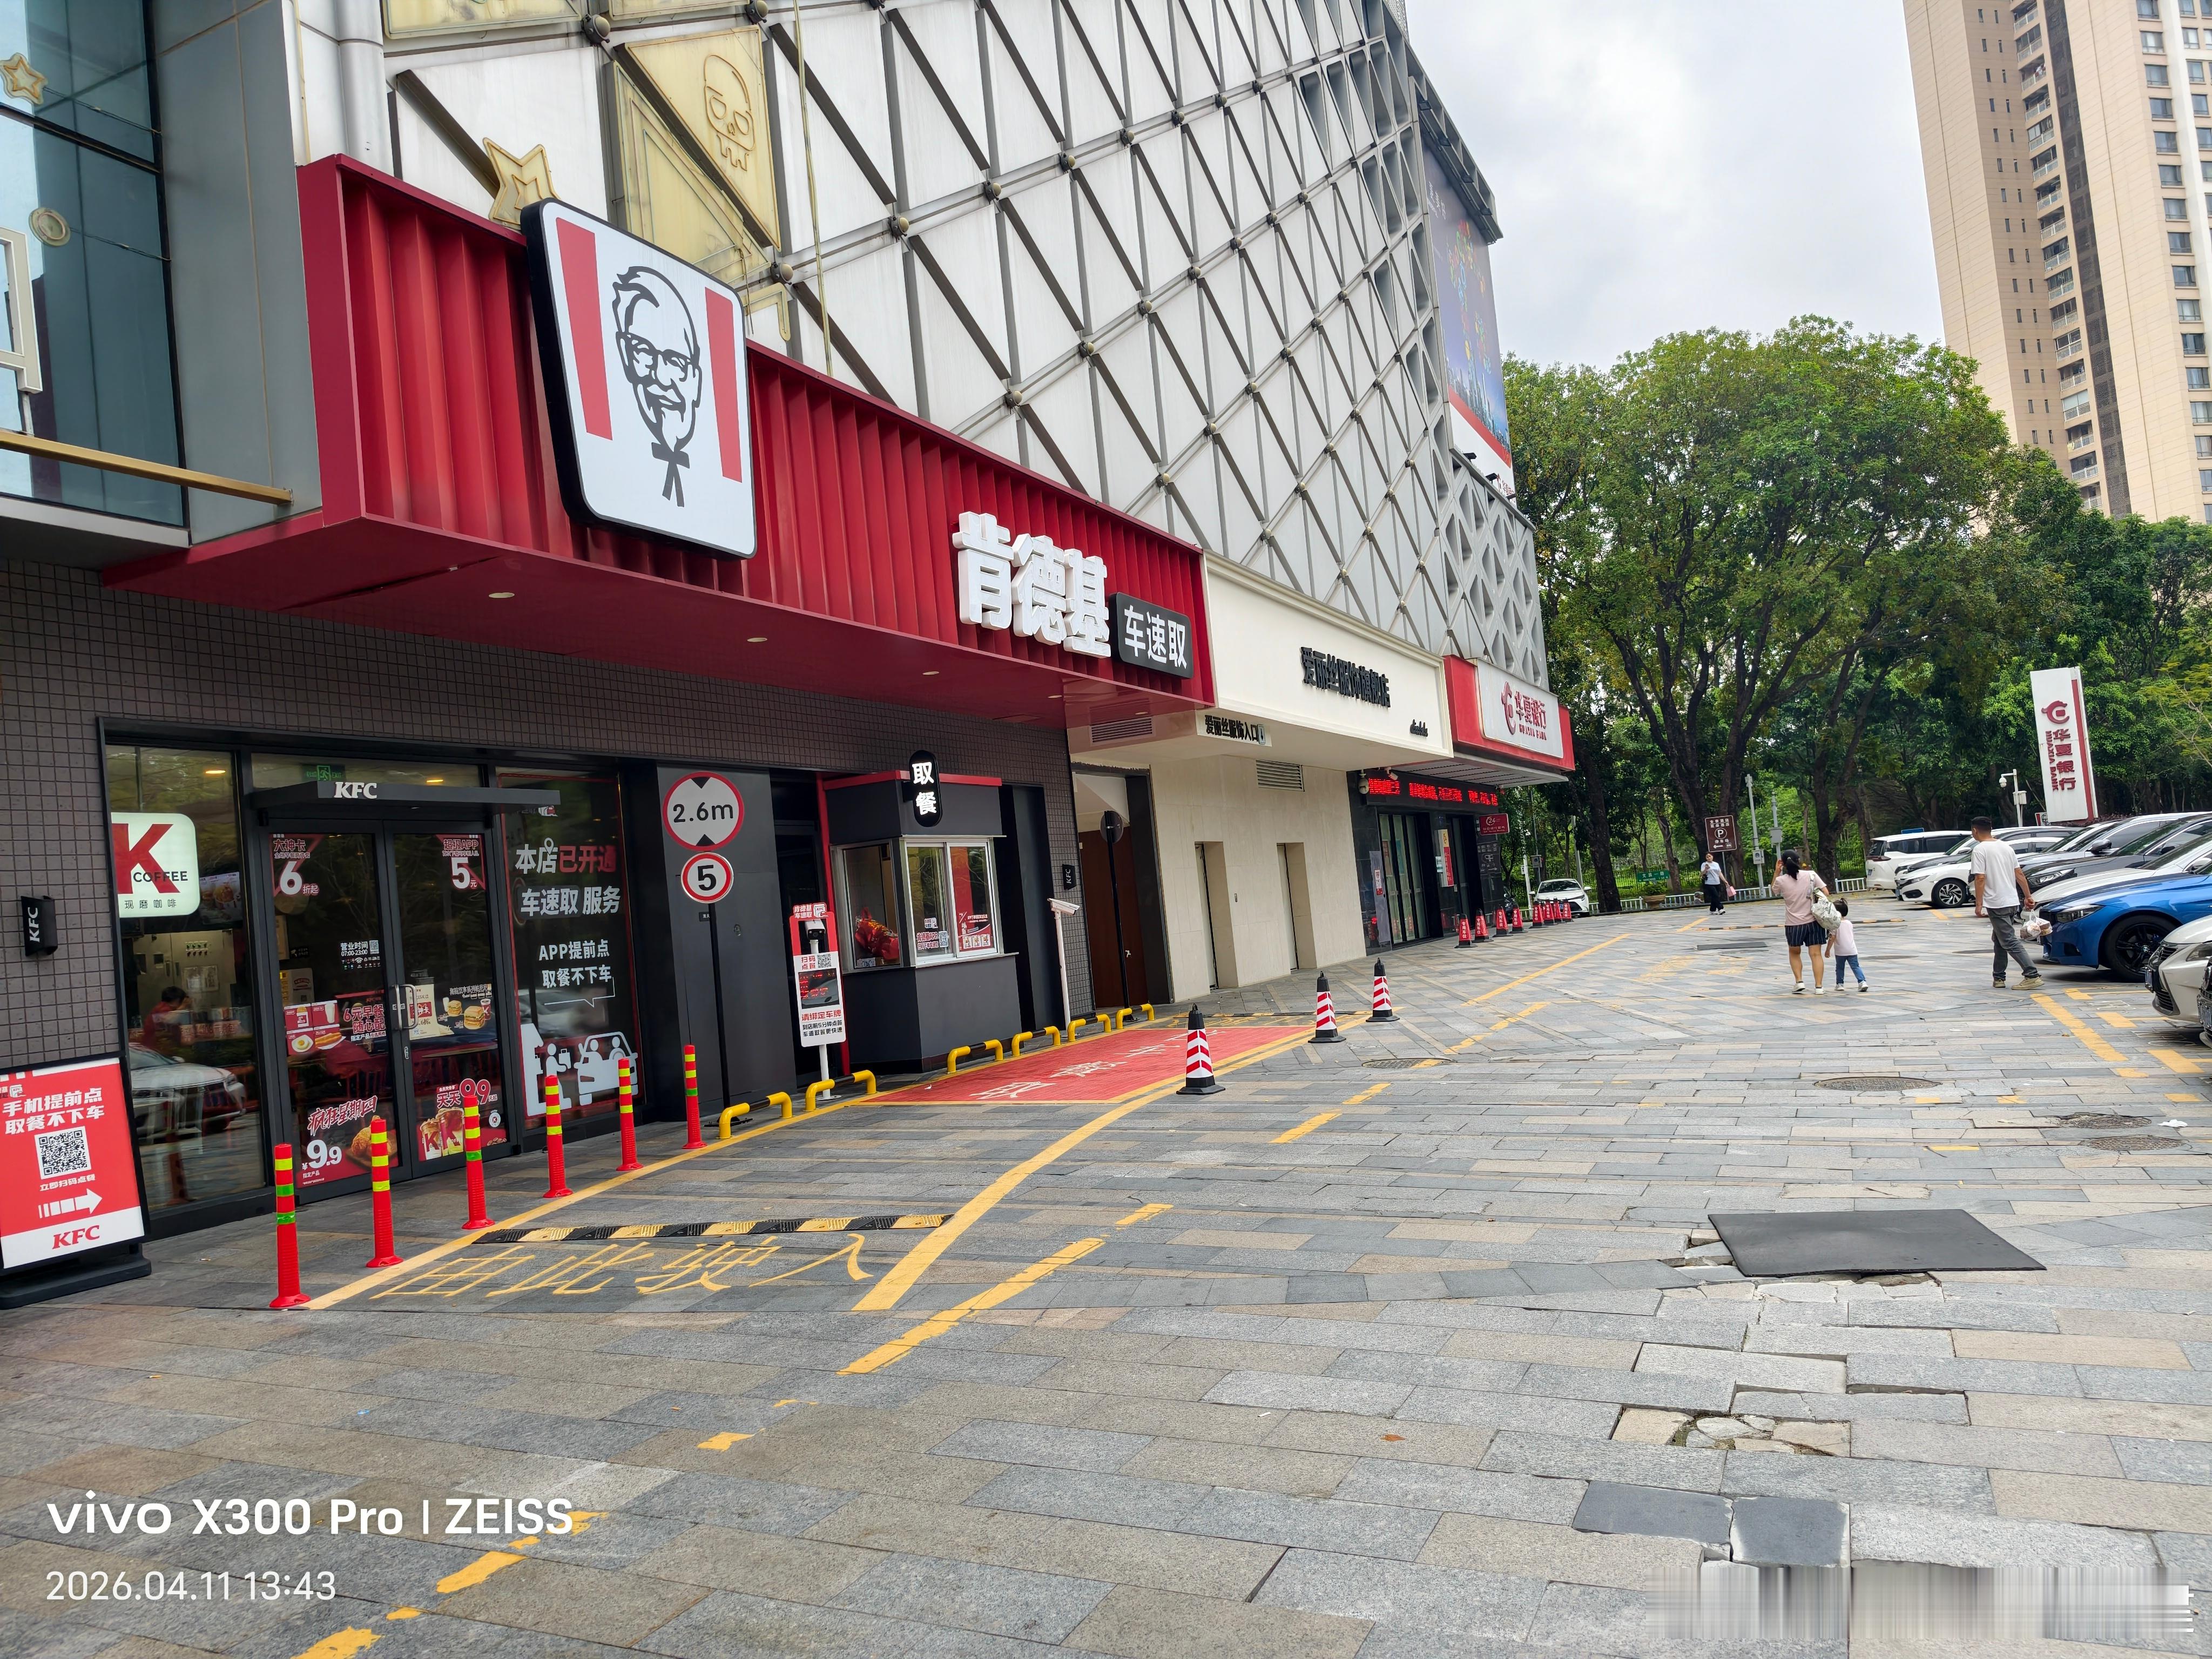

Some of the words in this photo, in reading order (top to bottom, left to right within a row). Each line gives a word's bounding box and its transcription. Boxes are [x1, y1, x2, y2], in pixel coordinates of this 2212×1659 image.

[953, 511, 1111, 659] 肯德基
[1124, 604, 1187, 669] 车速取
[1300, 646, 1391, 708] 爱丽丝服饰旗舰店
[1515, 691, 1547, 729] 华夏银行
[1205, 714, 1258, 741] 爱丽丝服饰入口
[2053, 729, 2076, 790] 华夏银行
[334, 781, 377, 799] KFC
[912, 761, 937, 815] 取餐
[672, 802, 734, 823] 2.6m
[274, 839, 306, 852] 大神卡
[443, 839, 479, 850] 超级APP
[1717, 829, 1724, 838] P
[111, 824, 180, 894] K
[515, 844, 617, 874] 本店已开通
[133, 871, 188, 882] COFFEE
[280, 861, 303, 895] 6
[302, 885, 320, 894] 折起
[451, 857, 470, 889] 5
[697, 865, 717, 891] 5
[124, 899, 177, 909] 现磨咖啡
[521, 888, 578, 916] 车速取
[582, 886, 621, 915] 服务
[29, 907, 40, 942] KFC
[340, 941, 368, 950] 营业时间
[539, 939, 610, 961] APP提前点
[542, 965, 612, 989] 取餐不下车
[343, 1004, 385, 1022] 6元早餐
[353, 1017, 386, 1034] 随心配
[802, 1009, 841, 1021] 请绑定车牌
[2, 1088, 103, 1117] 手机提前点
[437, 1090, 461, 1109] 天天
[5, 1105, 105, 1135] 取餐不下车
[307, 1095, 377, 1136] 疯狂星期四
[40, 1174, 96, 1191] 立即扫码点餐
[52, 1225, 100, 1249] KFC
[370, 1232, 874, 1298] 由此驶入
